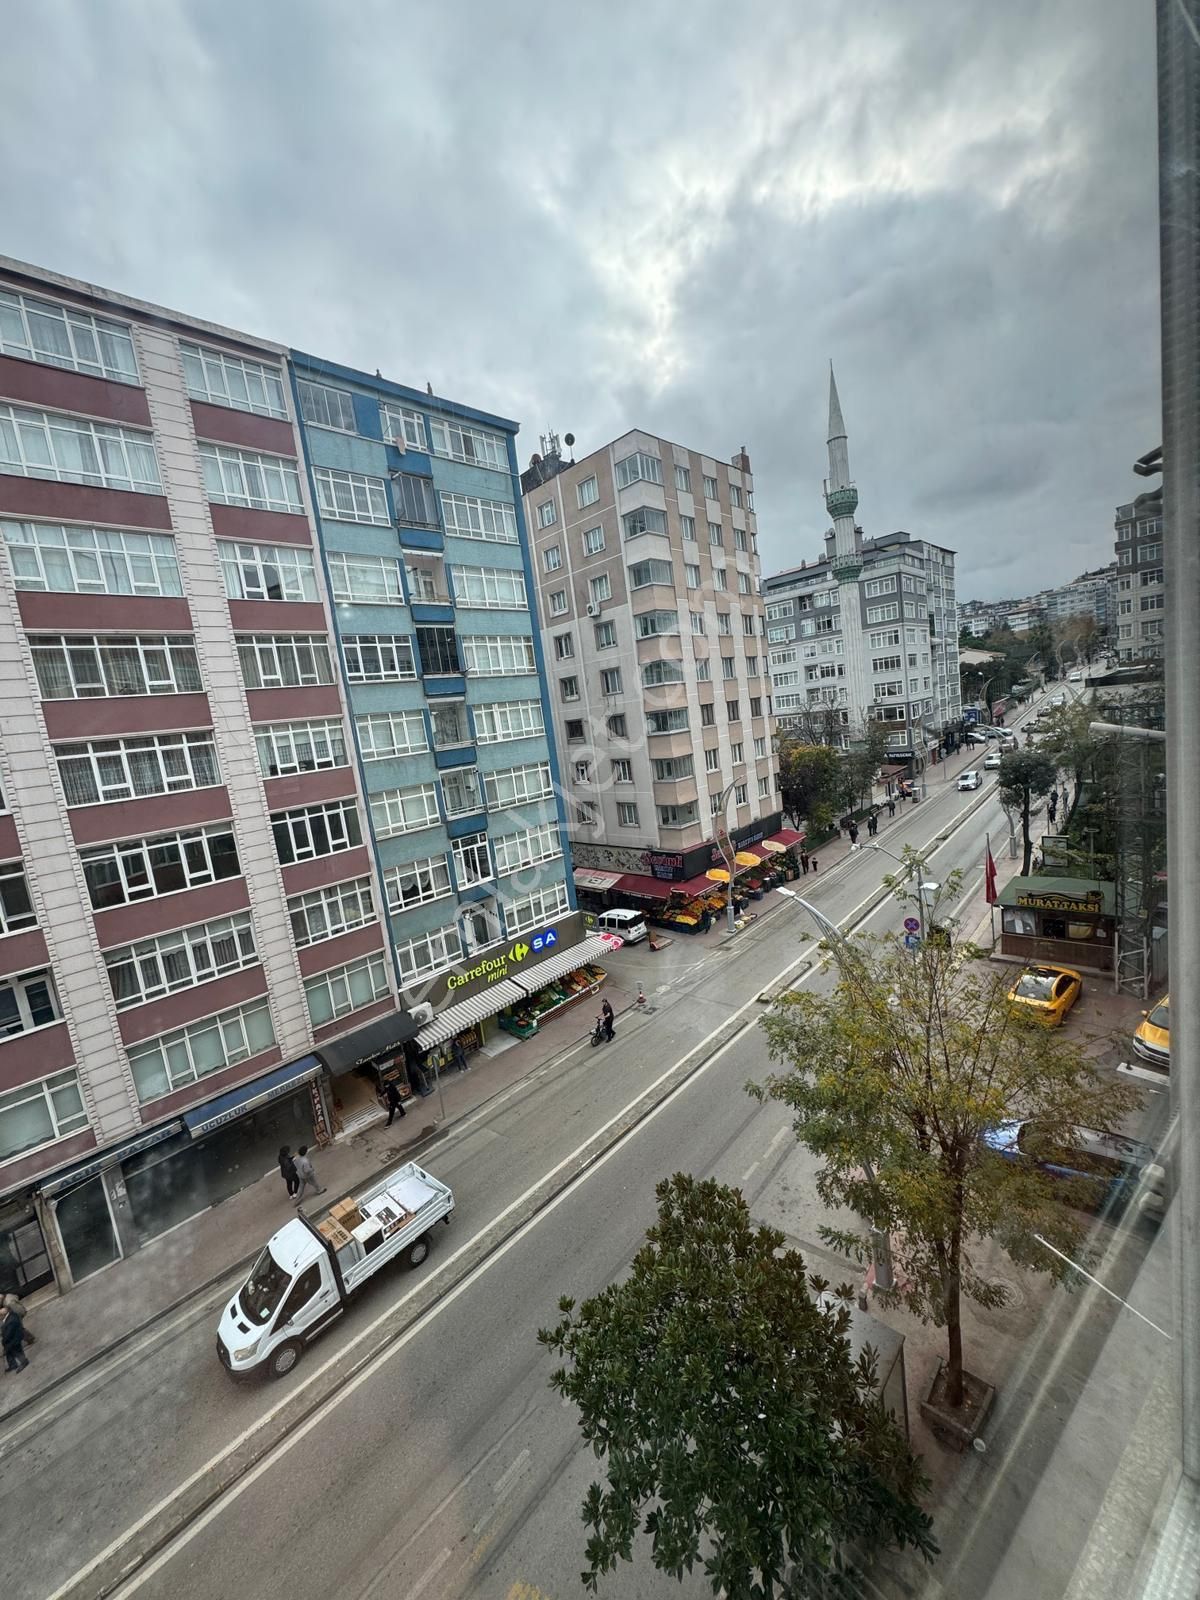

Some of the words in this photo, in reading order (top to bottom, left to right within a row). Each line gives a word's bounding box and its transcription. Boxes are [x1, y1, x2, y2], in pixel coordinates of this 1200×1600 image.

[1018, 896, 1060, 910] MURAT
[447, 954, 506, 990] Carrefour
[532, 931, 557, 951] SA
[487, 964, 508, 983] mini
[201, 1103, 249, 1132] UCUZLUK
